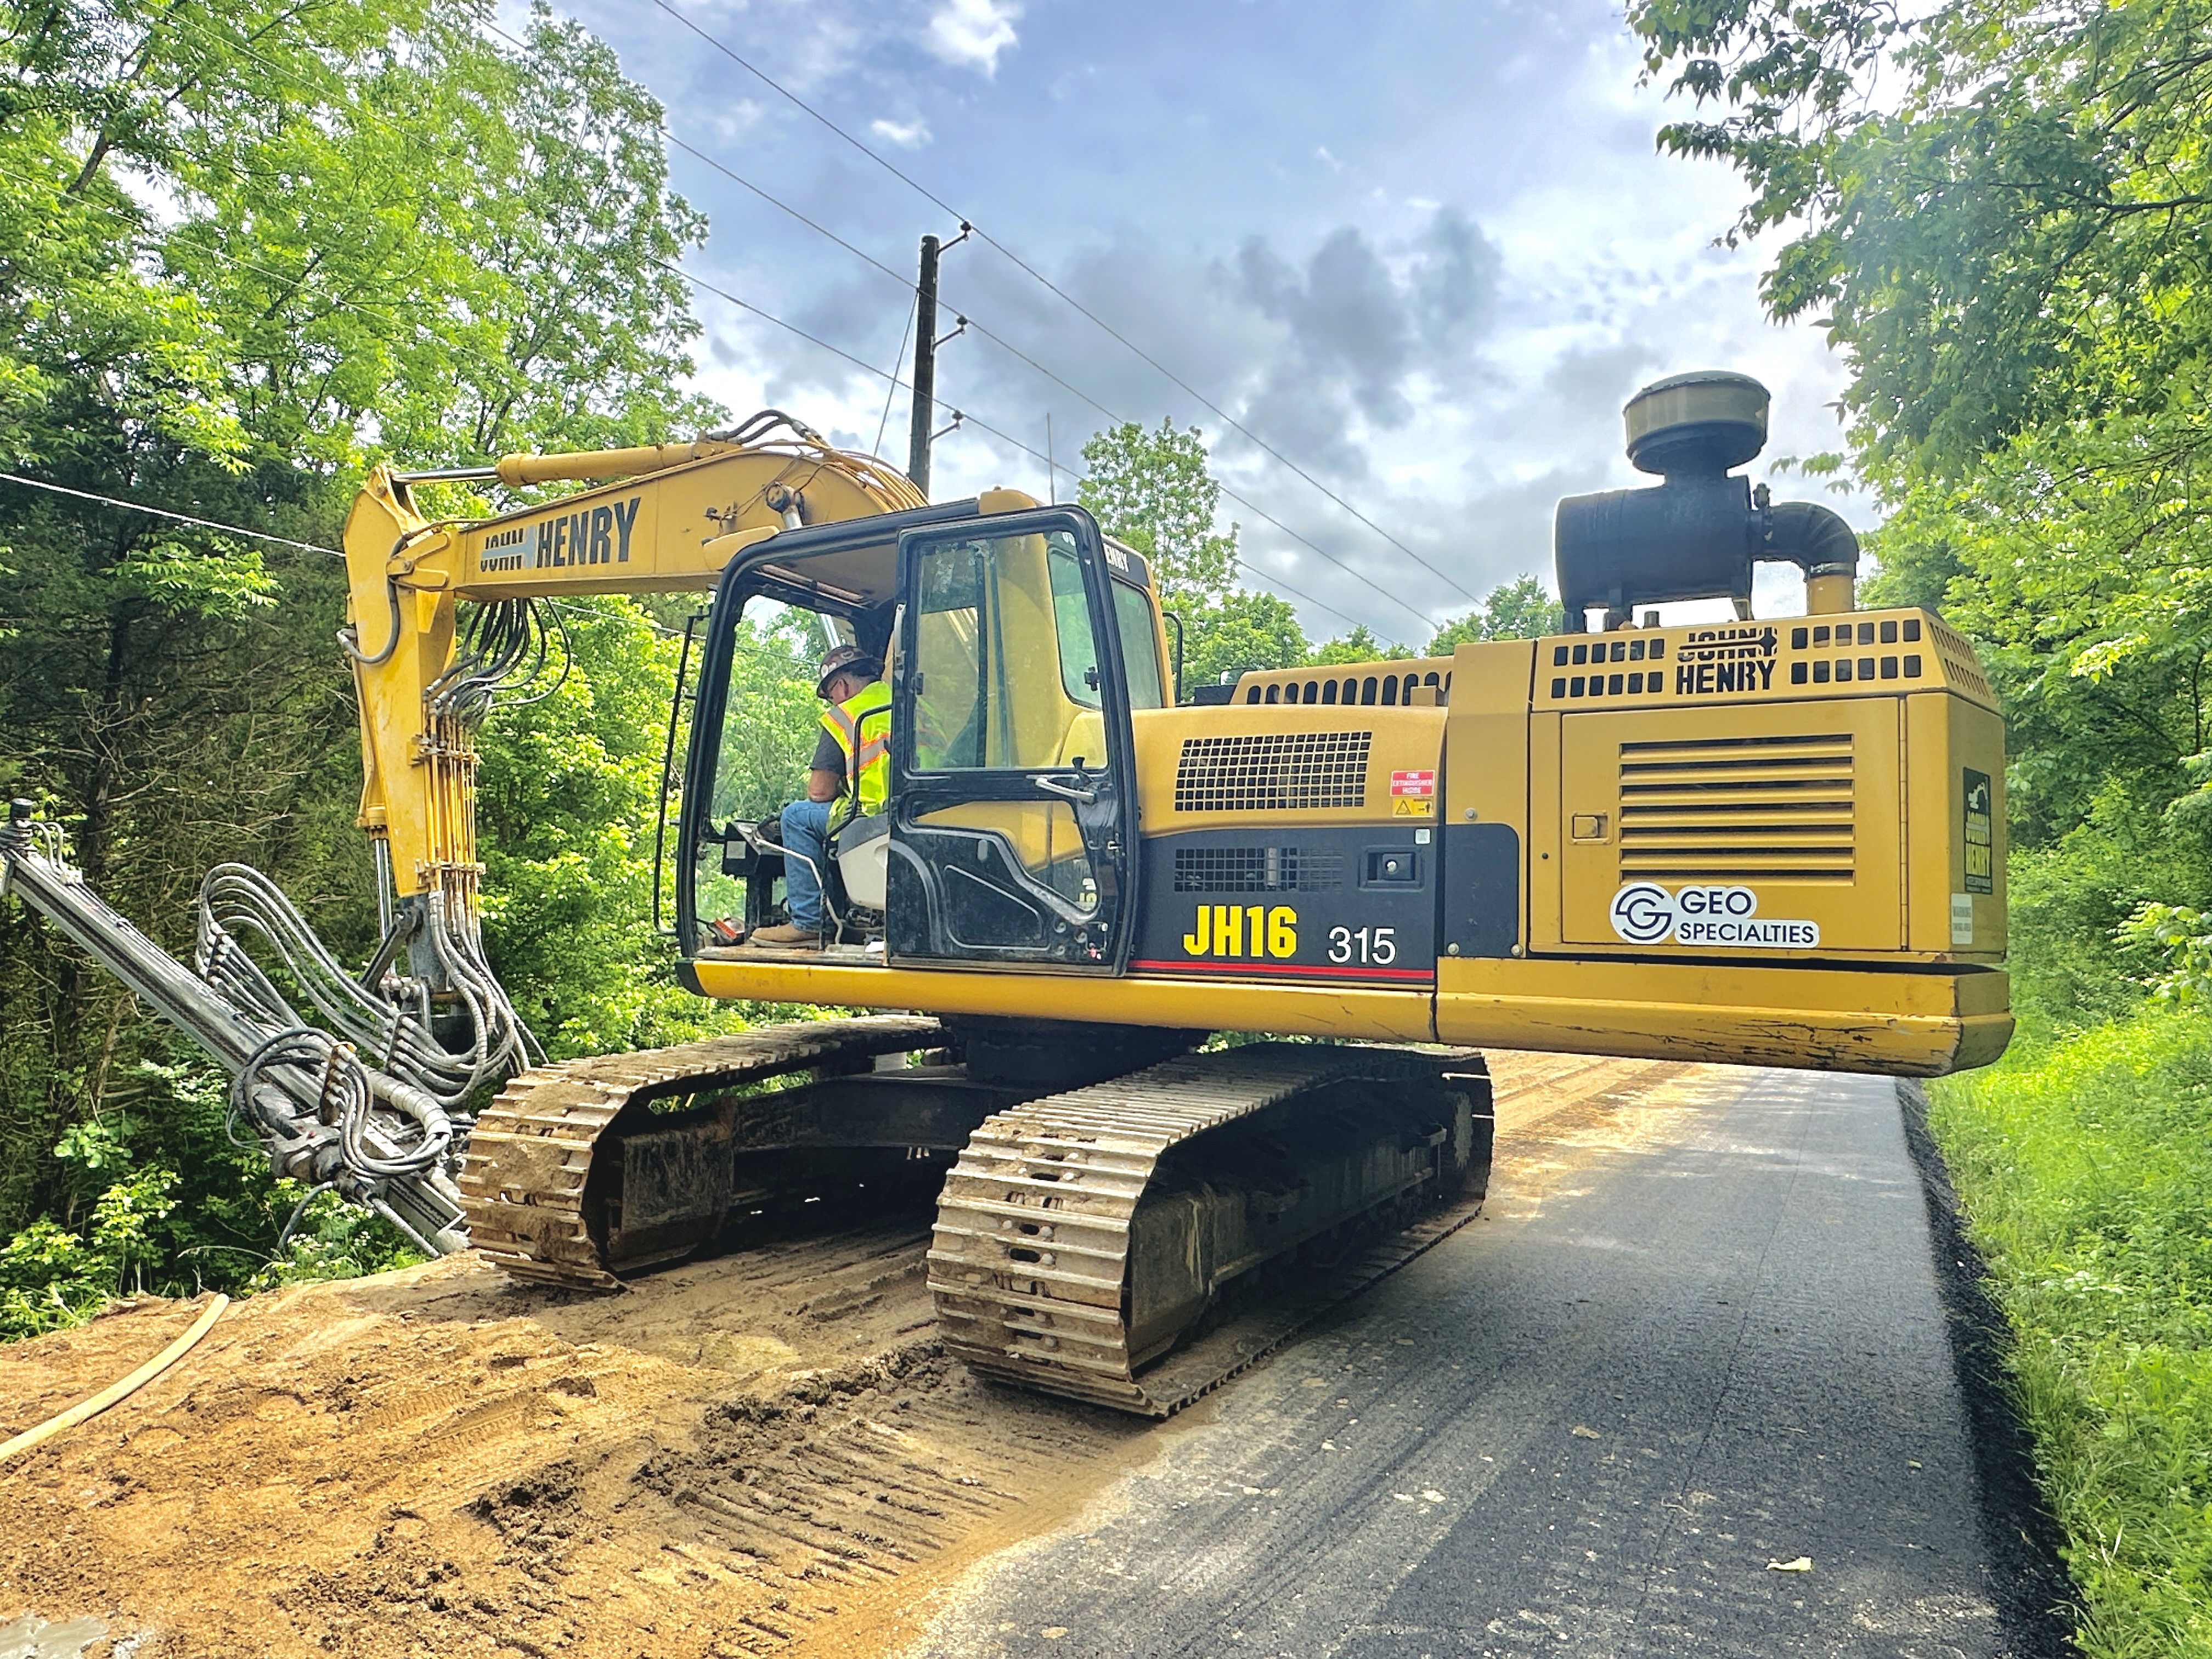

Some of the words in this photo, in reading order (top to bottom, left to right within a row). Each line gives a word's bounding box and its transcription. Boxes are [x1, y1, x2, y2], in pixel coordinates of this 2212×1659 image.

[537, 497, 641, 568] HENRY
[1677, 628, 1757, 662] JOHN
[1676, 659, 1776, 695] HENRY
[1680, 890, 1752, 915] GEO
[1183, 905, 1298, 958] JH16
[1328, 926, 1397, 964] 315
[1680, 922, 1814, 944] SPECIALTIES
